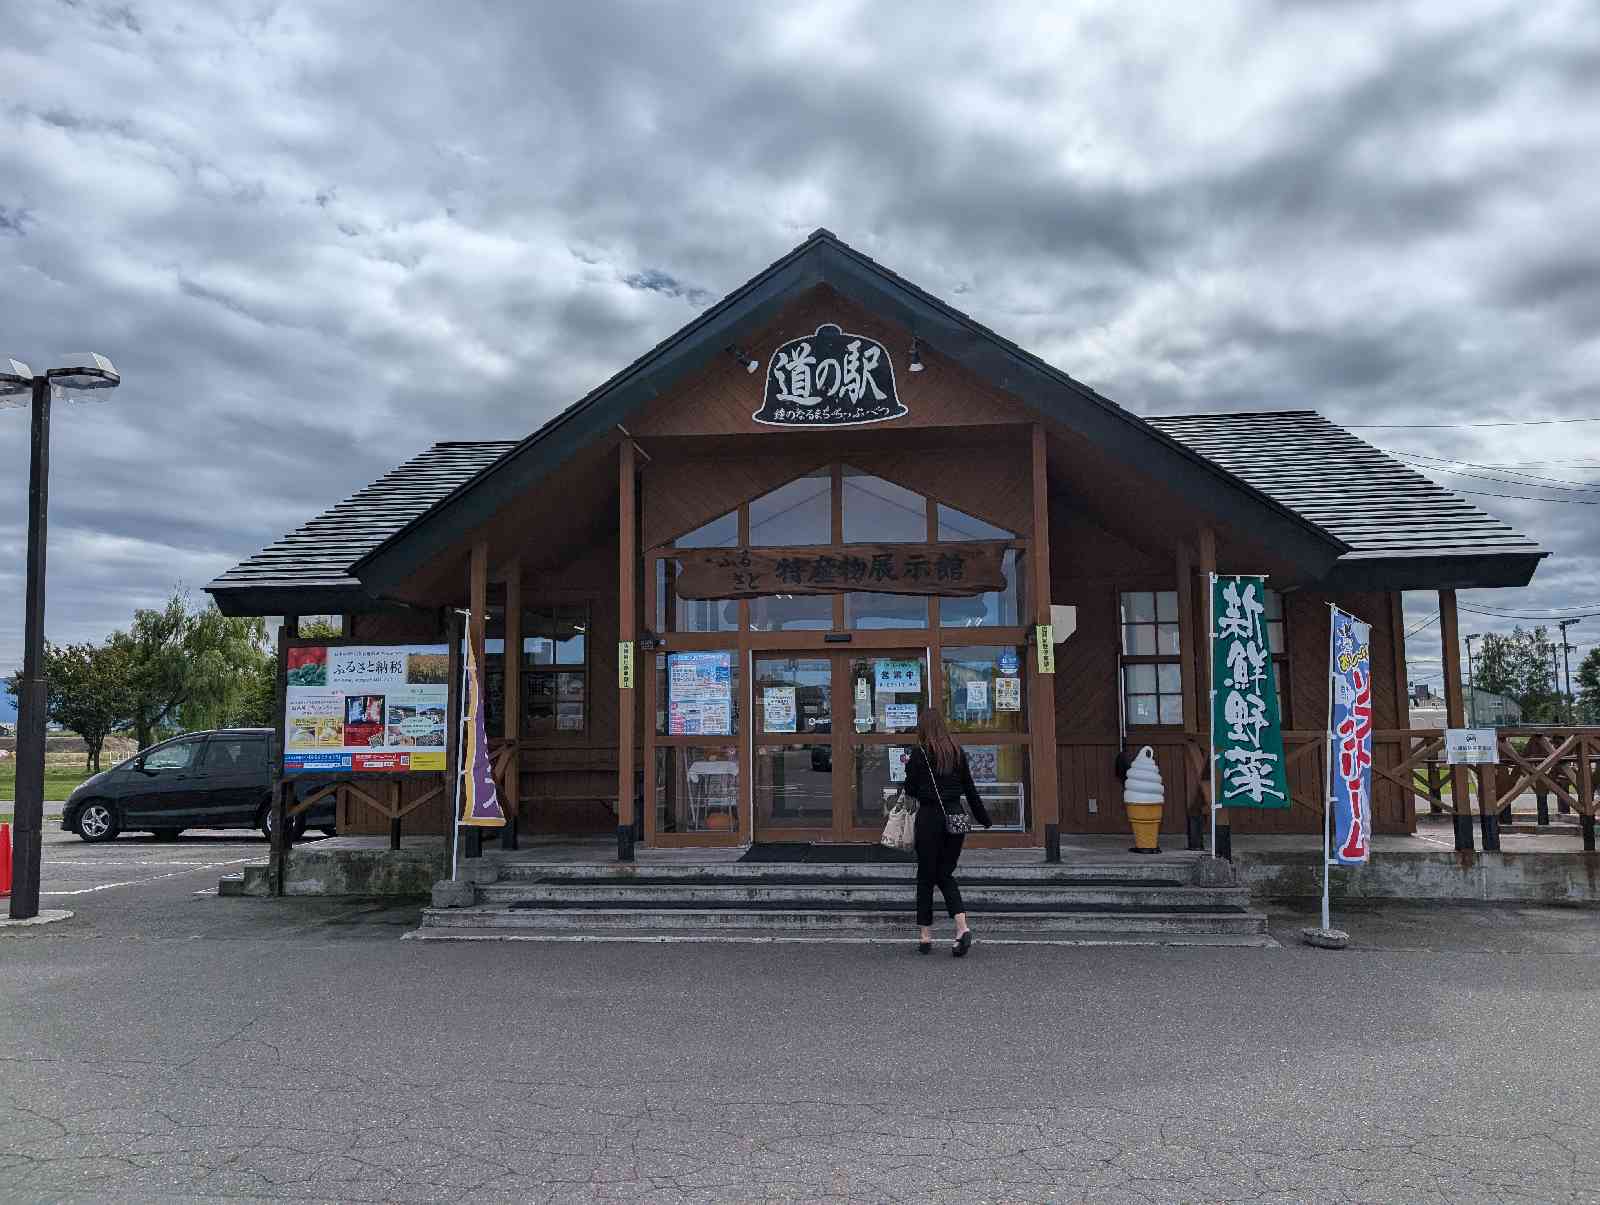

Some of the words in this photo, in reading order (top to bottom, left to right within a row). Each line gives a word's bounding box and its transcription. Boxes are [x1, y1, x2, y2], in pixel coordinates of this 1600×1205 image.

[774, 340, 887, 406] 道の駅
[333, 660, 403, 675] ふるさと納税
[1218, 581, 1286, 803] 新鮮野菜
